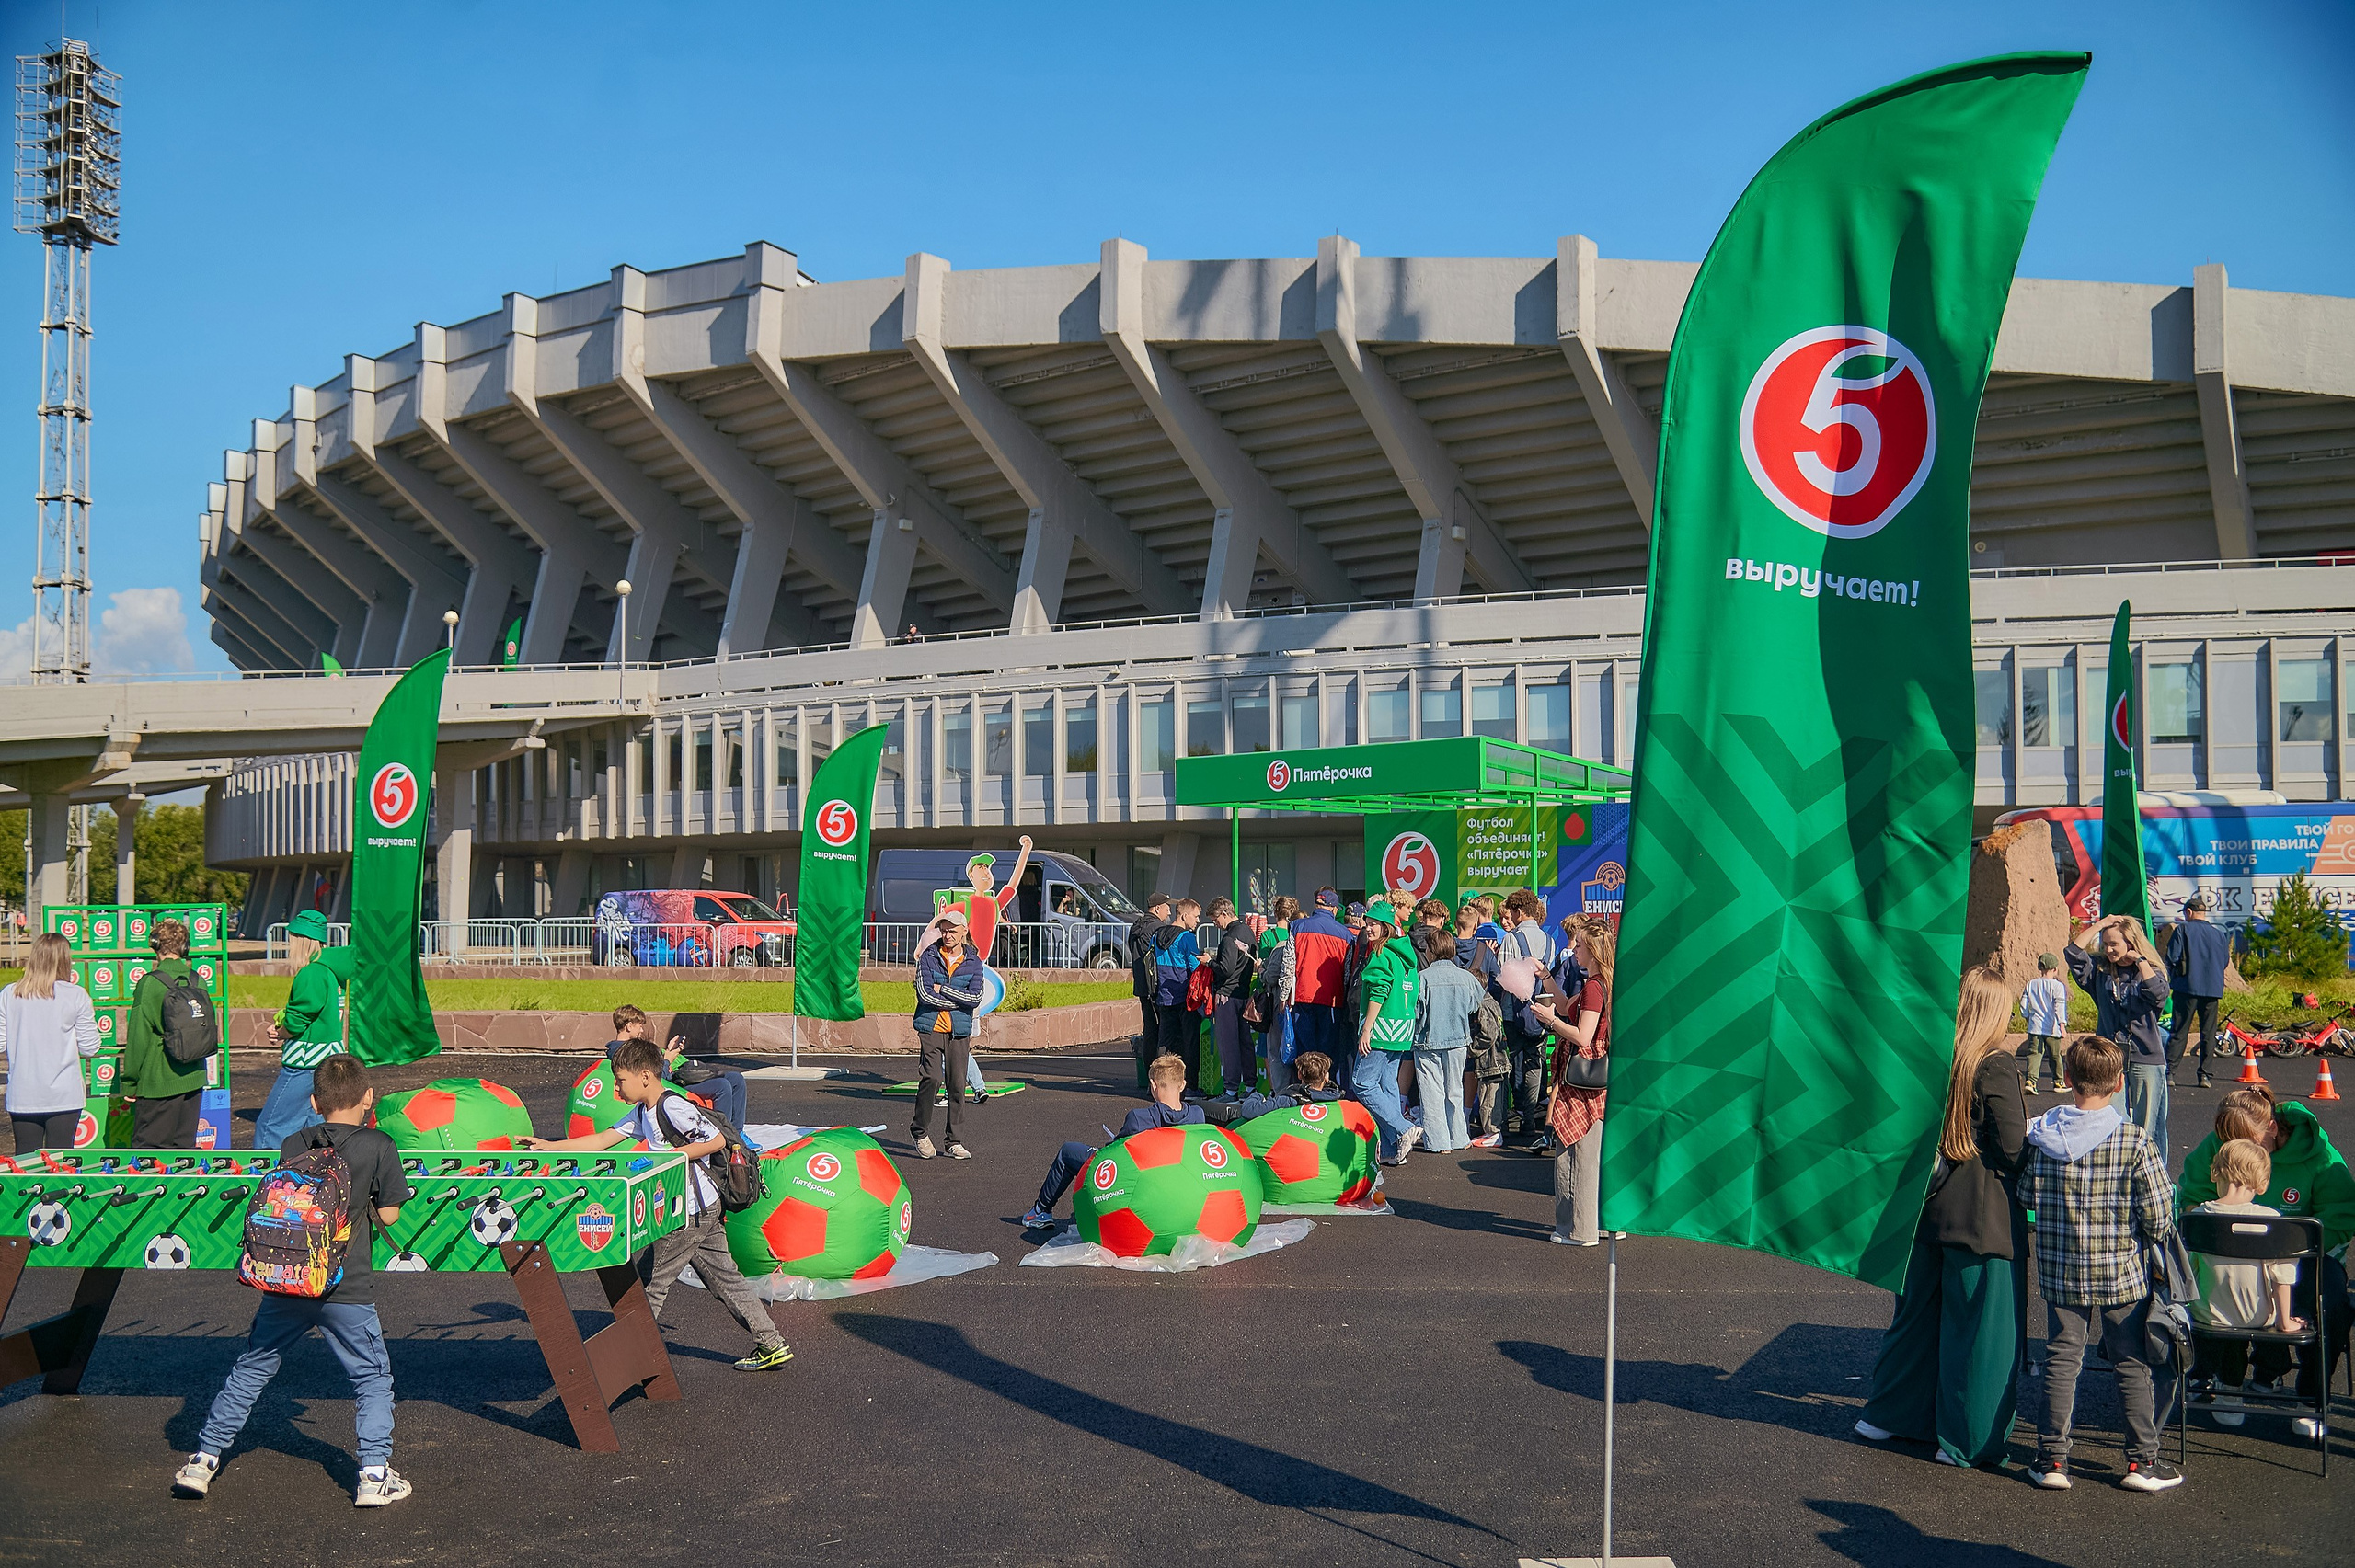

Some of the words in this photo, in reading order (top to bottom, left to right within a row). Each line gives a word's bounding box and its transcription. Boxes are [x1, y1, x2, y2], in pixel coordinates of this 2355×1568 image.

[1725, 558, 1920, 608] выручает!
[1293, 765, 1372, 784] Пятёрочка
[1466, 816, 1514, 830] Футбол
[2294, 821, 2334, 836] ТВОЙ
[368, 837, 417, 848] выручает!
[2210, 840, 2248, 852] ТВОИ
[2251, 838, 2319, 851] ПРАВИЛА
[813, 851, 856, 862] выручает!
[2178, 852, 2215, 866] ТВОЙ
[2219, 853, 2257, 865] КЛУБ
[1467, 864, 1529, 878] выручает
[2191, 886, 2242, 911] ФК
[2252, 886, 2355, 911] ЕСЕ
[1289, 1118, 1324, 1134] Пятёрочка
[1202, 1171, 1237, 1181] Пятёрочка
[792, 1176, 836, 1197] Пятёрочка
[1093, 1188, 1124, 1204] Пятёрочка
[578, 1221, 615, 1233] ЕНИСЕЙ
[242, 1253, 311, 1279] Crewmate
